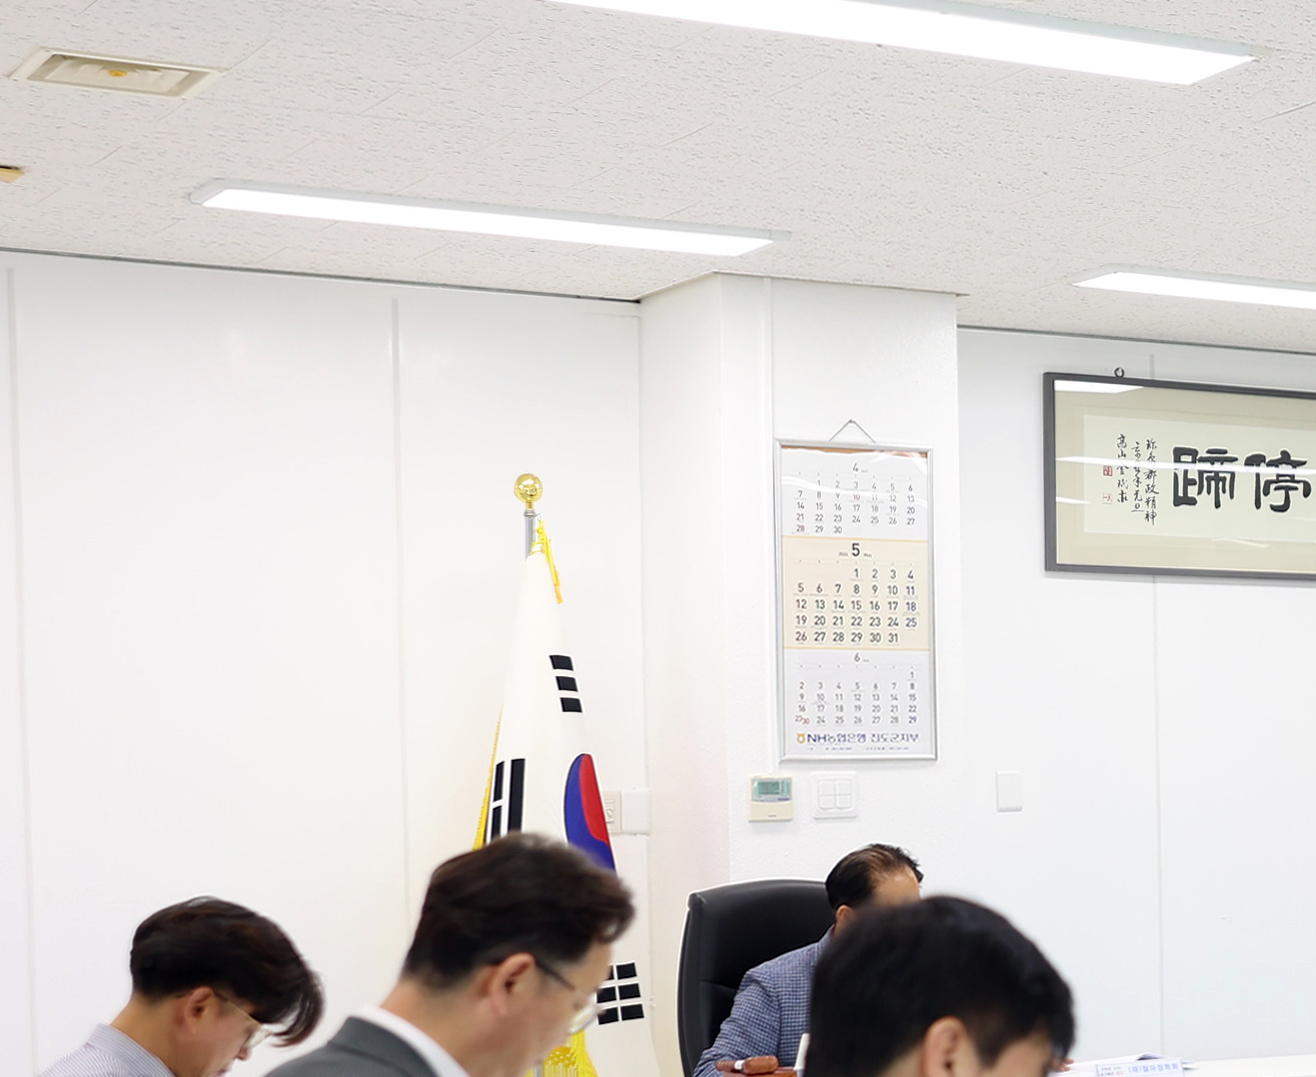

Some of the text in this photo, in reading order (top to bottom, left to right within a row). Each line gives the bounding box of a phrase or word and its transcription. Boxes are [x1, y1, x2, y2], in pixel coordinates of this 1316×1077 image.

[852, 543, 860, 557] 5
[854, 568, 914, 580] 1 2 3 4
[798, 582, 915, 596] 5 6 7 8 9 10 11
[796, 599, 917, 612] 12 13 14 15 16 17 18
[796, 615, 917, 628] 19 20 21 22 23 24 25
[796, 631, 898, 643] 26 27 28 29 30 31
